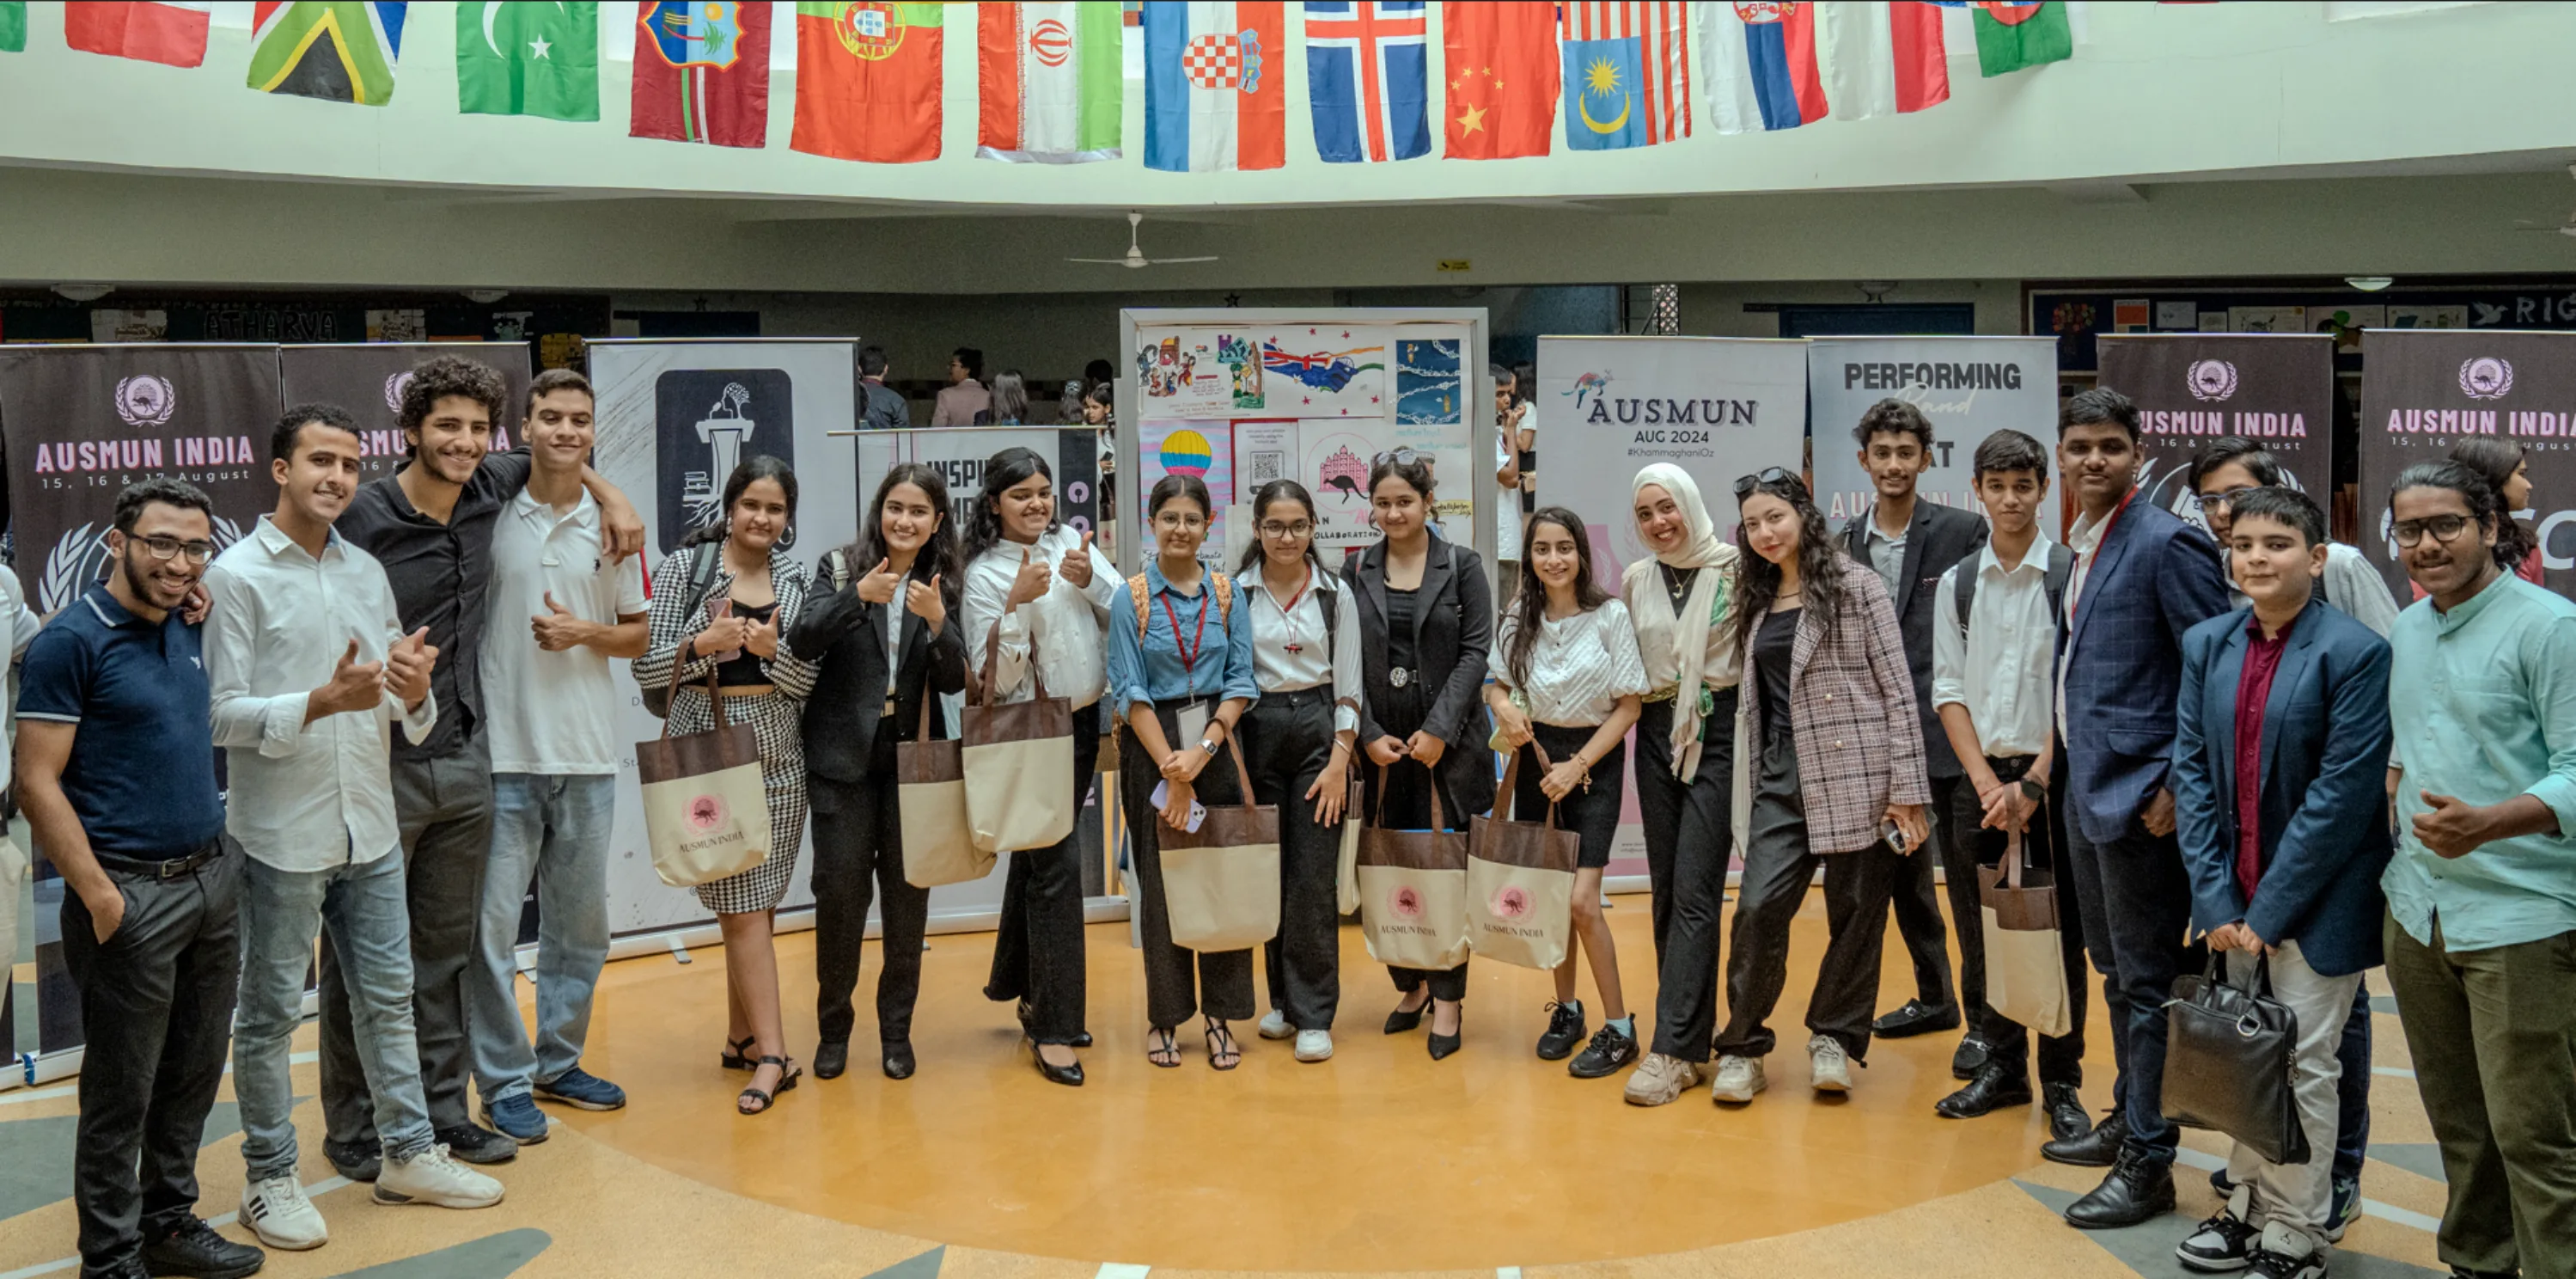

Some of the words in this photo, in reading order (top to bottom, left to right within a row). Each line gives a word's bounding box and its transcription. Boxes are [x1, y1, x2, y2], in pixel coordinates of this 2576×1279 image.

[204, 310, 338, 341] ATHARVA
[1845, 363, 2021, 389] PERFORMING
[1588, 398, 1758, 425] AUSMUN
[2387, 409, 2496, 434] AUSMUN
[2140, 411, 2223, 435] USMUN
[2234, 412, 2307, 438] INDIA
[1634, 431, 1665, 443] AUG
[1670, 431, 1709, 443] 2024
[2161, 438, 2176, 447] 16
[2188, 438, 2196, 448] &
[2428, 438, 2445, 446] 16
[36, 439, 163, 473] AUSMUN
[174, 437, 254, 467] INDIA
[362, 461, 379, 470] 16
[42, 478, 72, 489] 15,
[89, 474, 107, 487] 16
[122, 474, 131, 485] &
[178, 470, 249, 483] August
[927, 460, 990, 487] INSPI
[679, 838, 717, 853] AUSMUN
[718, 830, 744, 845] INDIA
[1381, 925, 1416, 935] AUSMUN
[1416, 927, 1437, 938] INDIA
[1483, 922, 1518, 937] AUSMUN
[1519, 926, 1544, 938] INDIA
